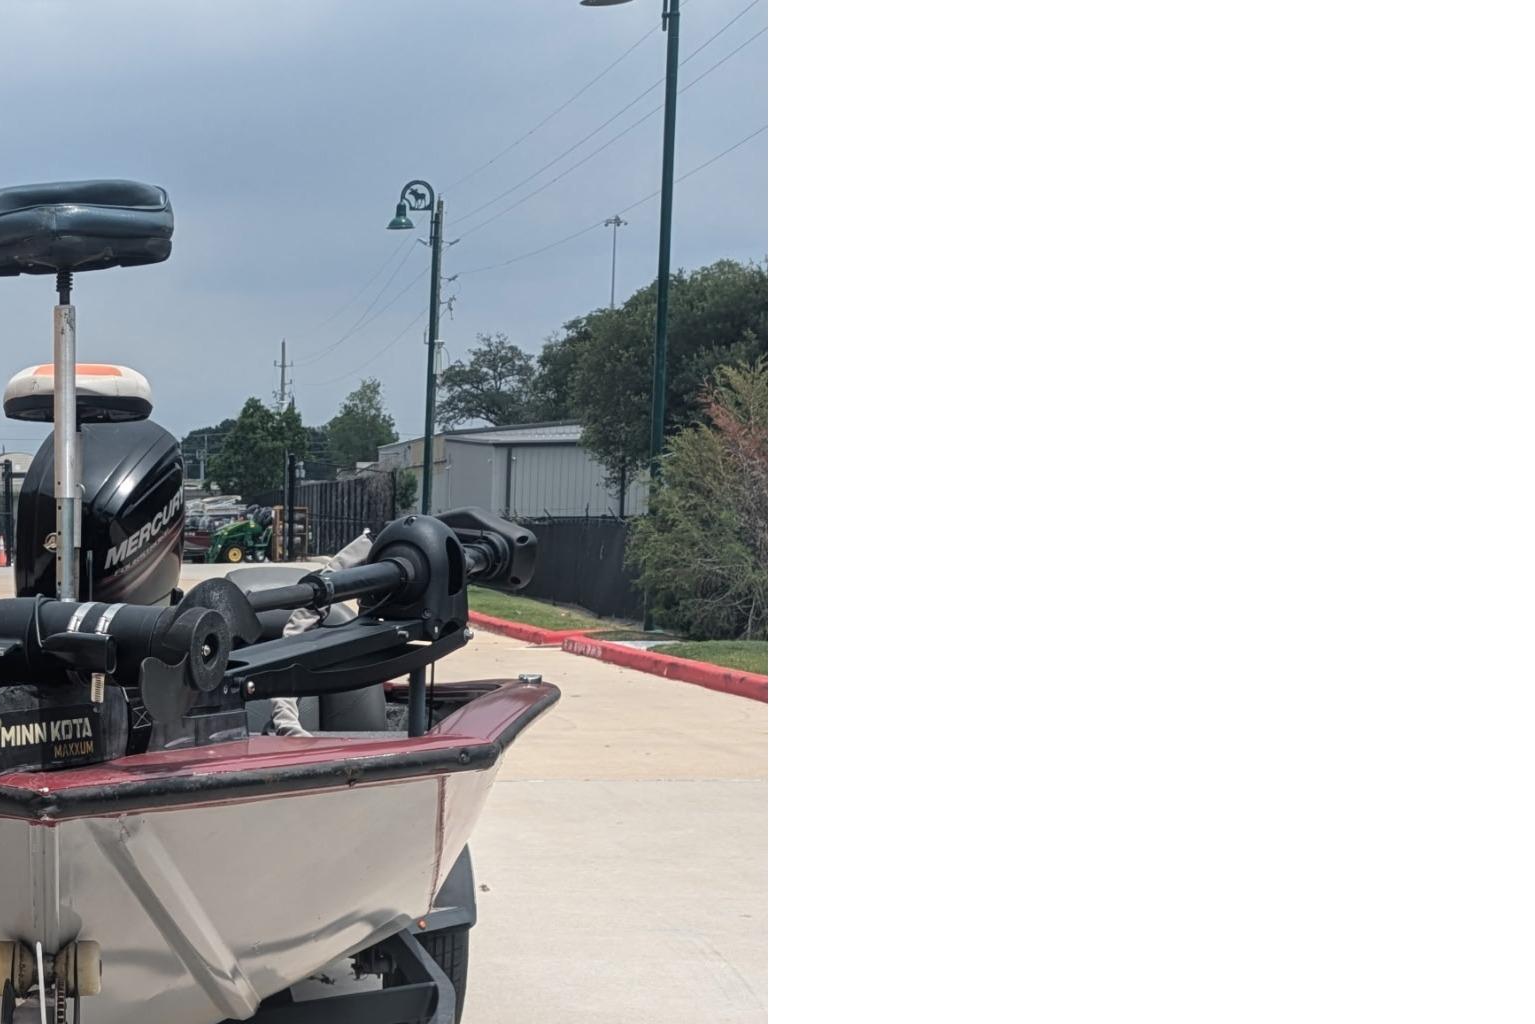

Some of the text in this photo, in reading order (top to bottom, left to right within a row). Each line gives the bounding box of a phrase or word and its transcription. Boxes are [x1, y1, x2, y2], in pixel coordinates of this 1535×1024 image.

[0, 717, 93, 748] MINN KOTA
[53, 740, 94, 758] MAXXUM
